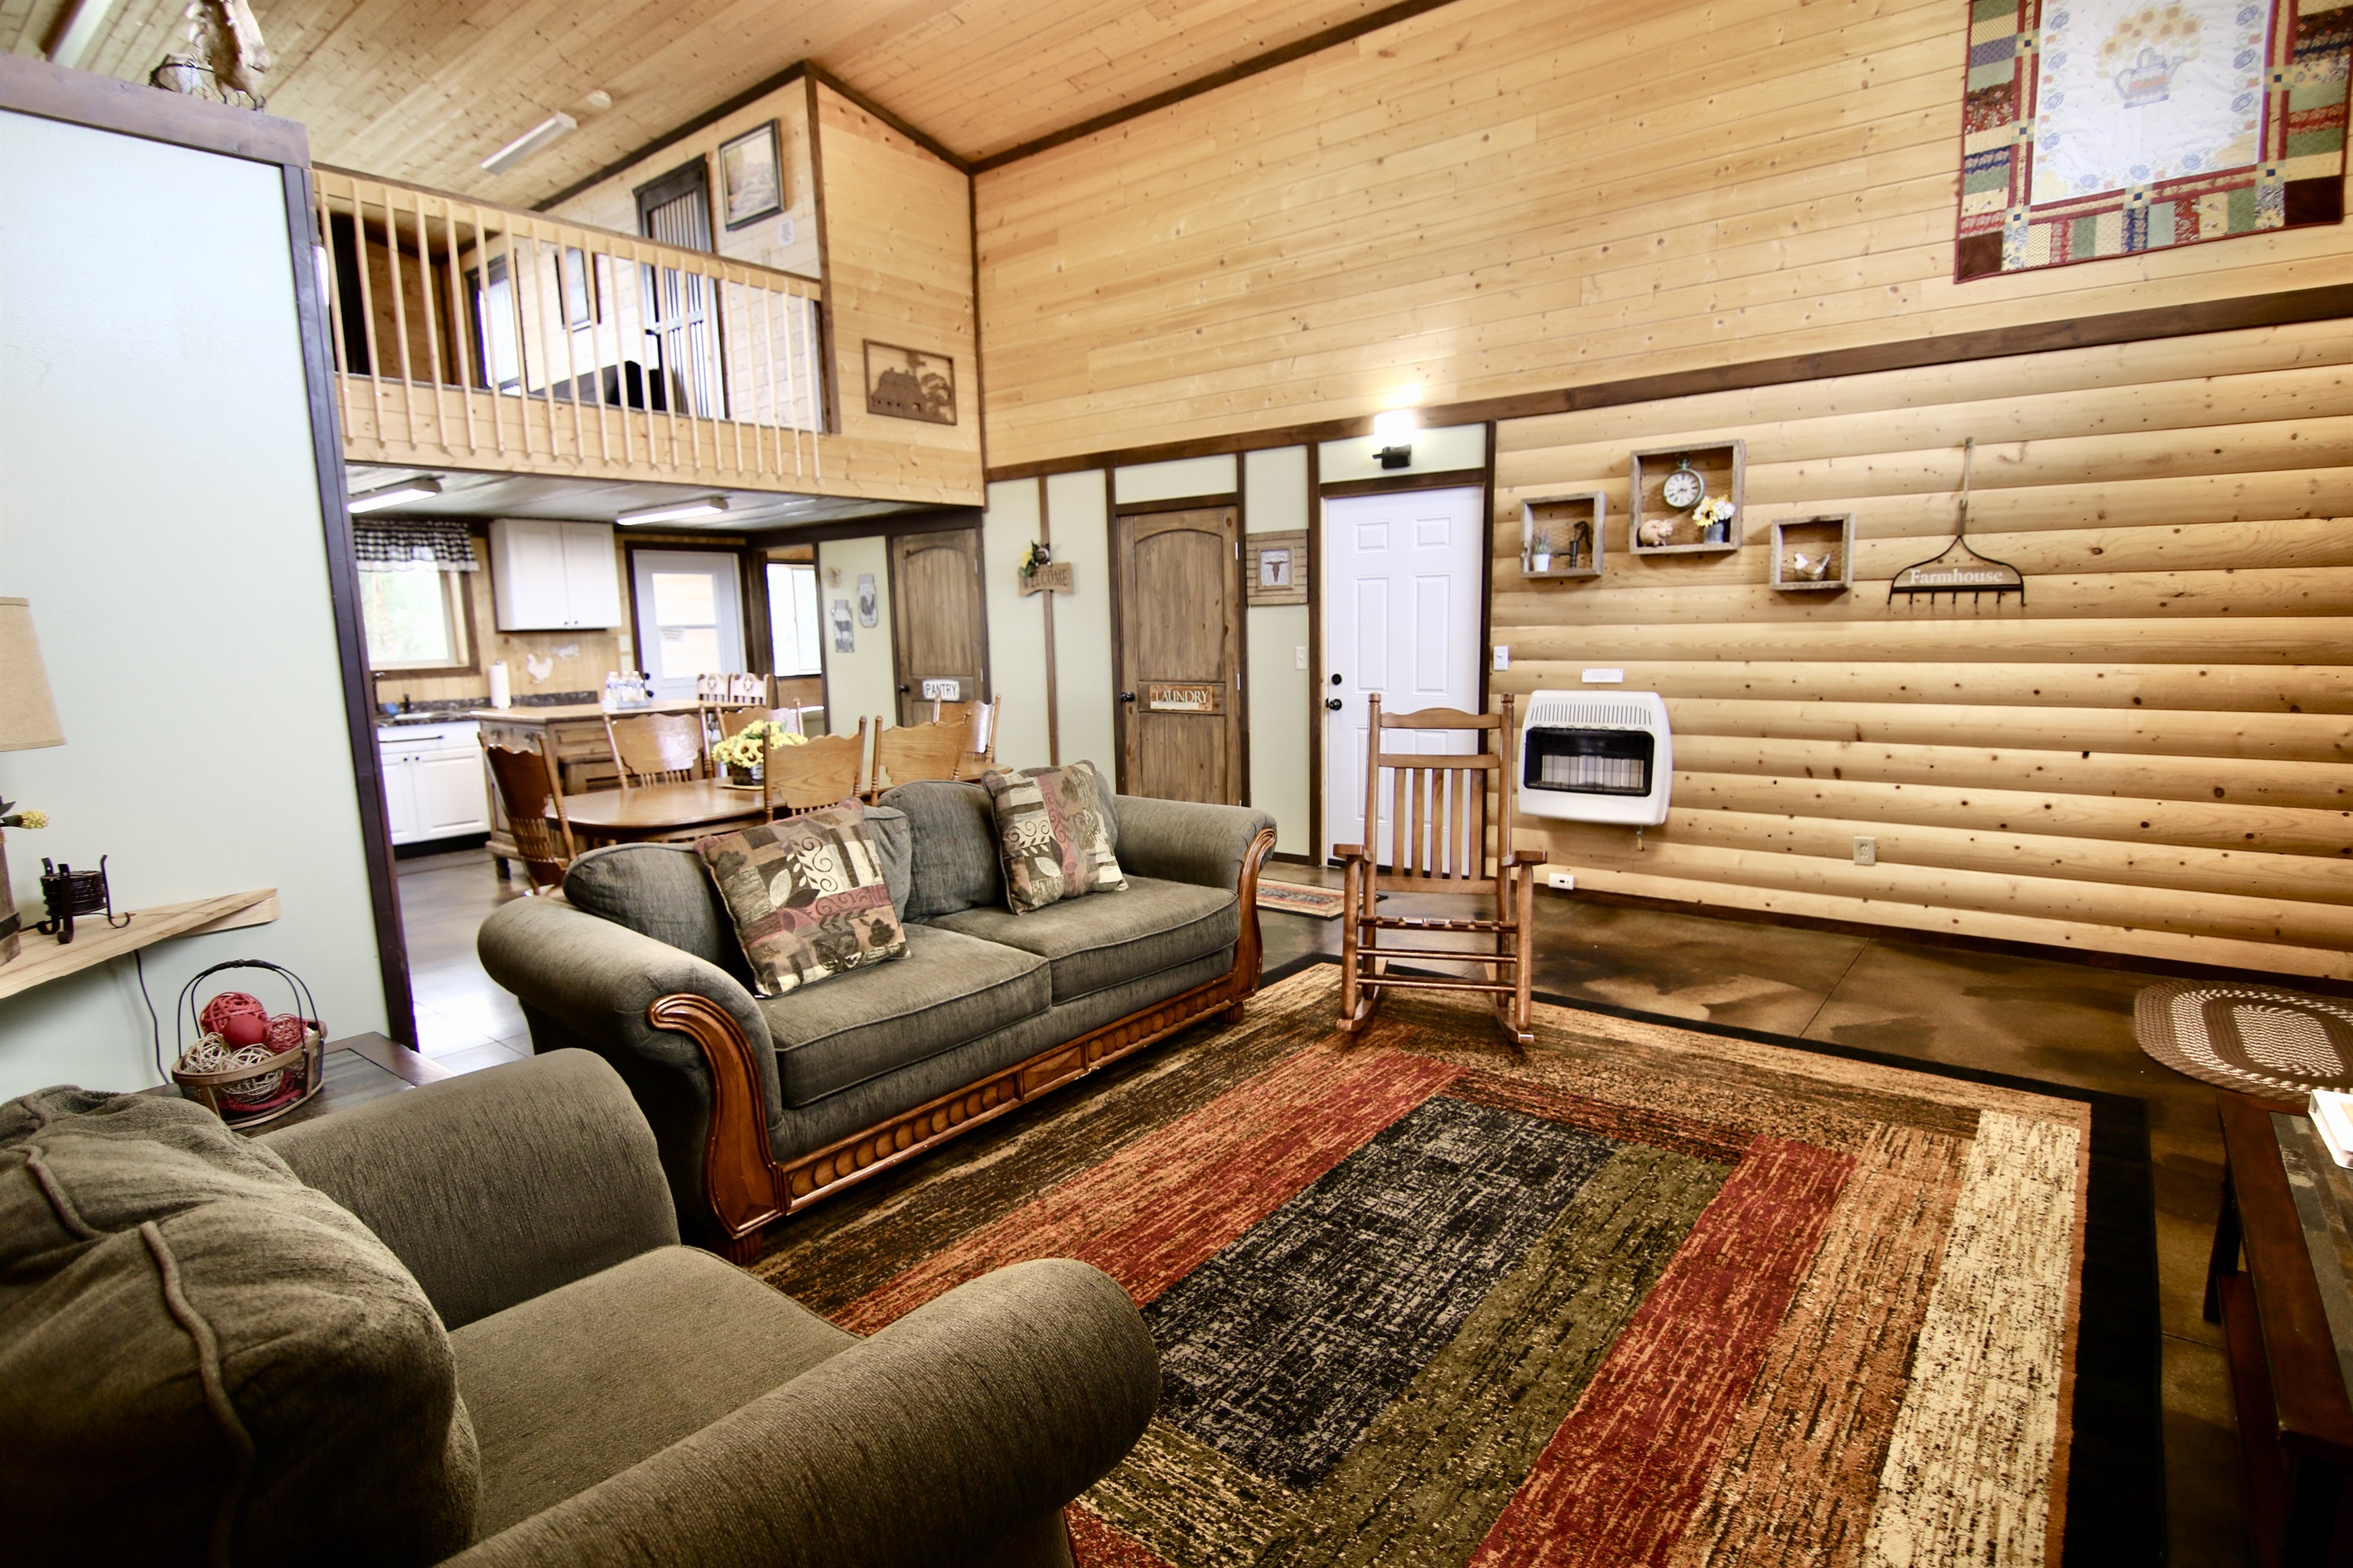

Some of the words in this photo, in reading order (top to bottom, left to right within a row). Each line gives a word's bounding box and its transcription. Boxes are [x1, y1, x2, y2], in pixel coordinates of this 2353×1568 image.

[1023, 570, 1068, 589] WELCOME
[1909, 568, 2003, 585] Farmhouse
[925, 683, 957, 697] PANTRY
[1156, 689, 1209, 703] LAUNDRY
